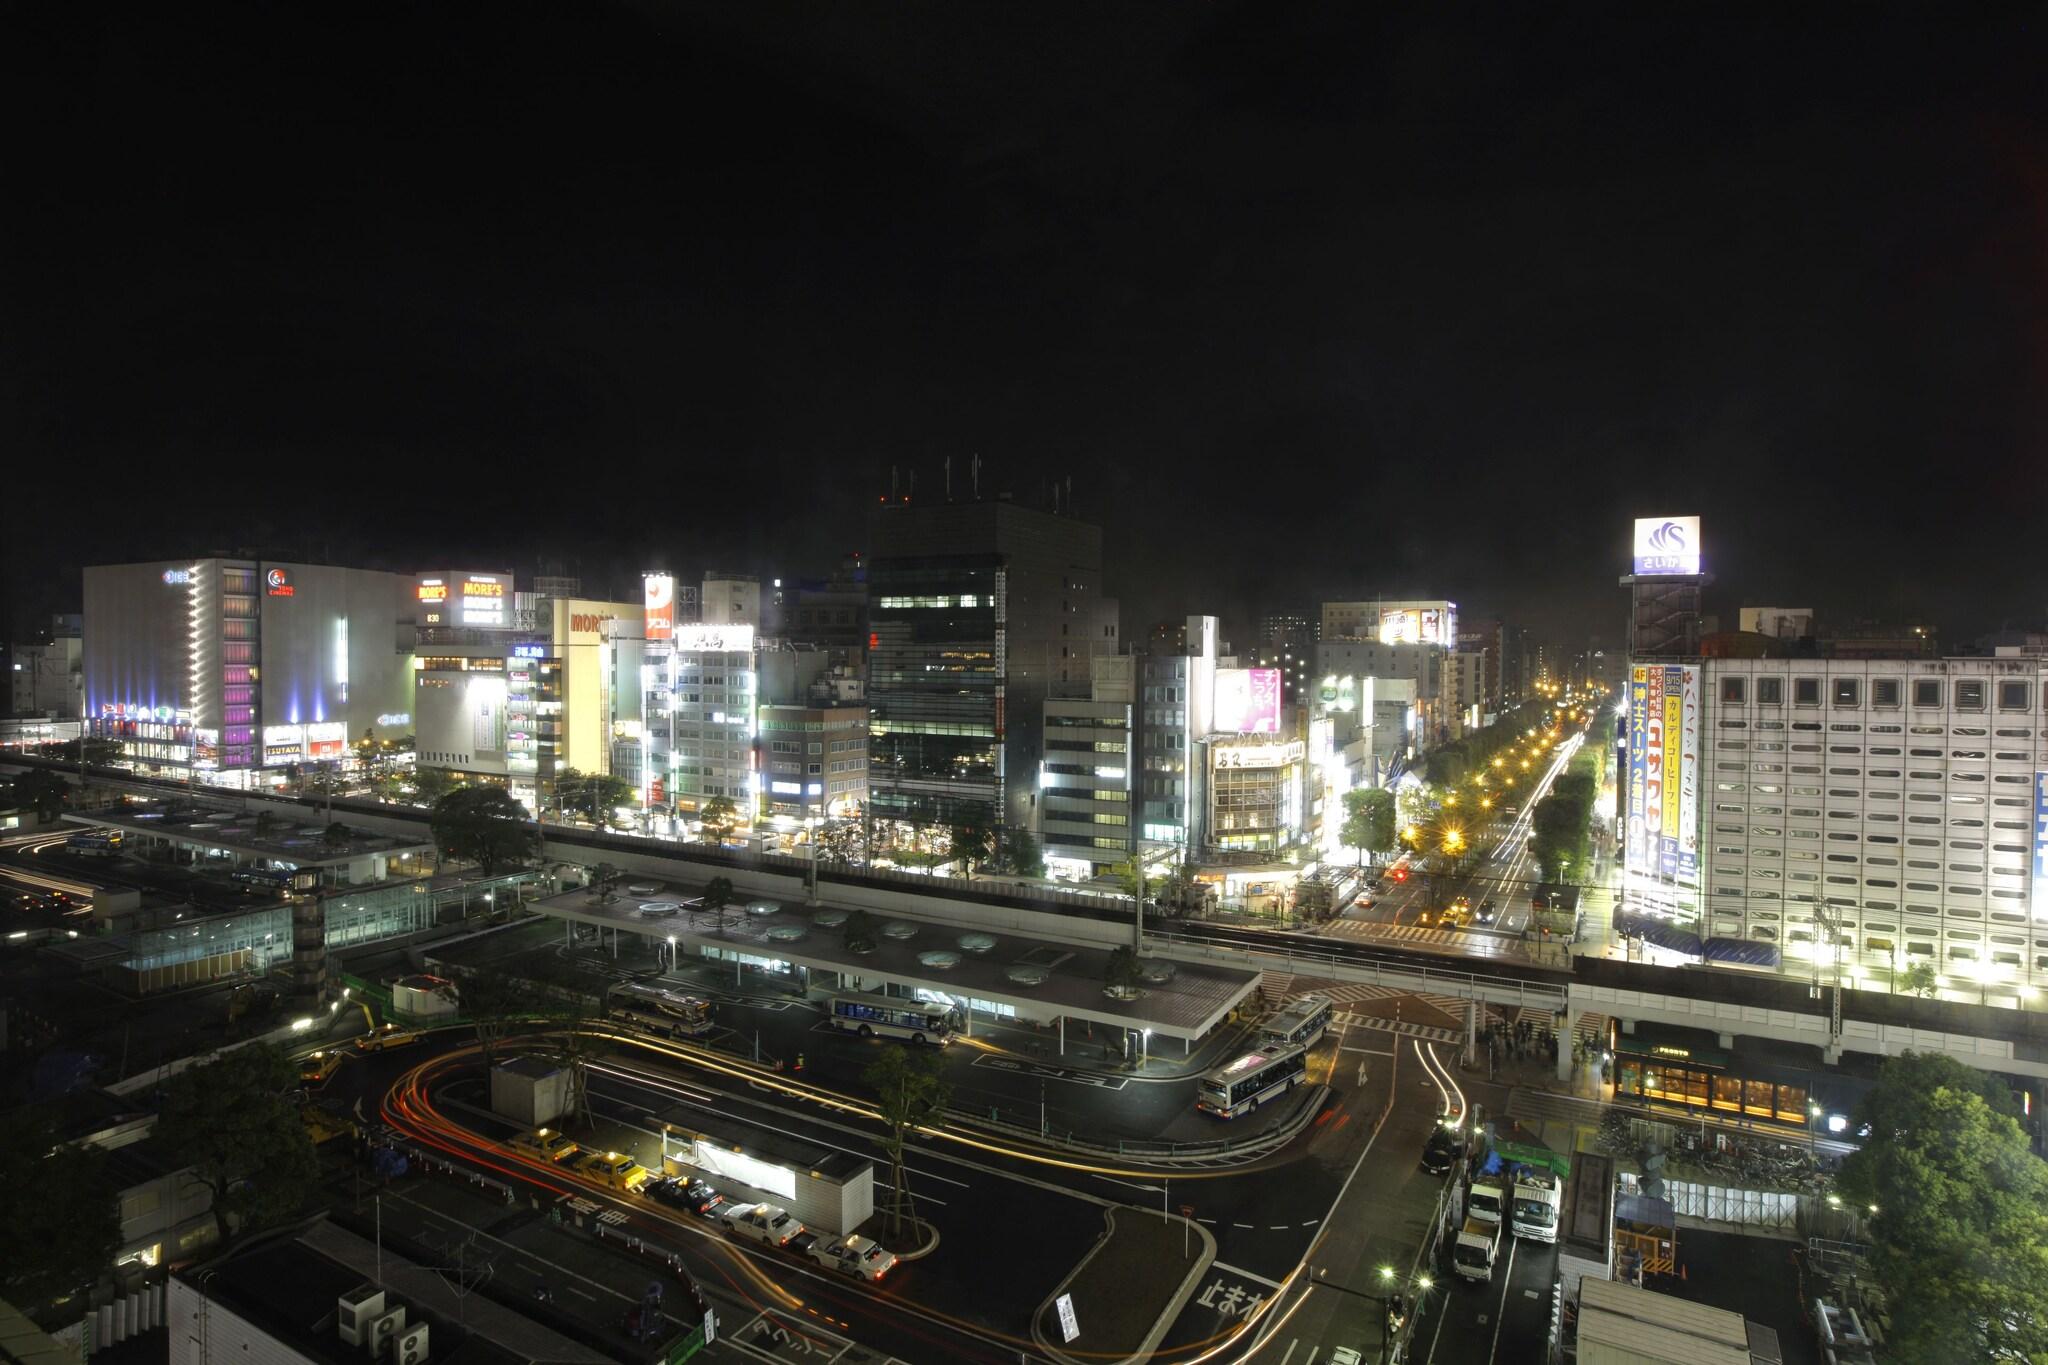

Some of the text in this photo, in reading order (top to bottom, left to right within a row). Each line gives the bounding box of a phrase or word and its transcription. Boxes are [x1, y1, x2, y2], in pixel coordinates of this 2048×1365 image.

[419, 586, 447, 599] MORE'S
[464, 583, 502, 596] MORE'S
[647, 618, 671, 629] アコム
[1634, 670, 1645, 680] 4F
[267, 746, 301, 755] TSUTAYA
